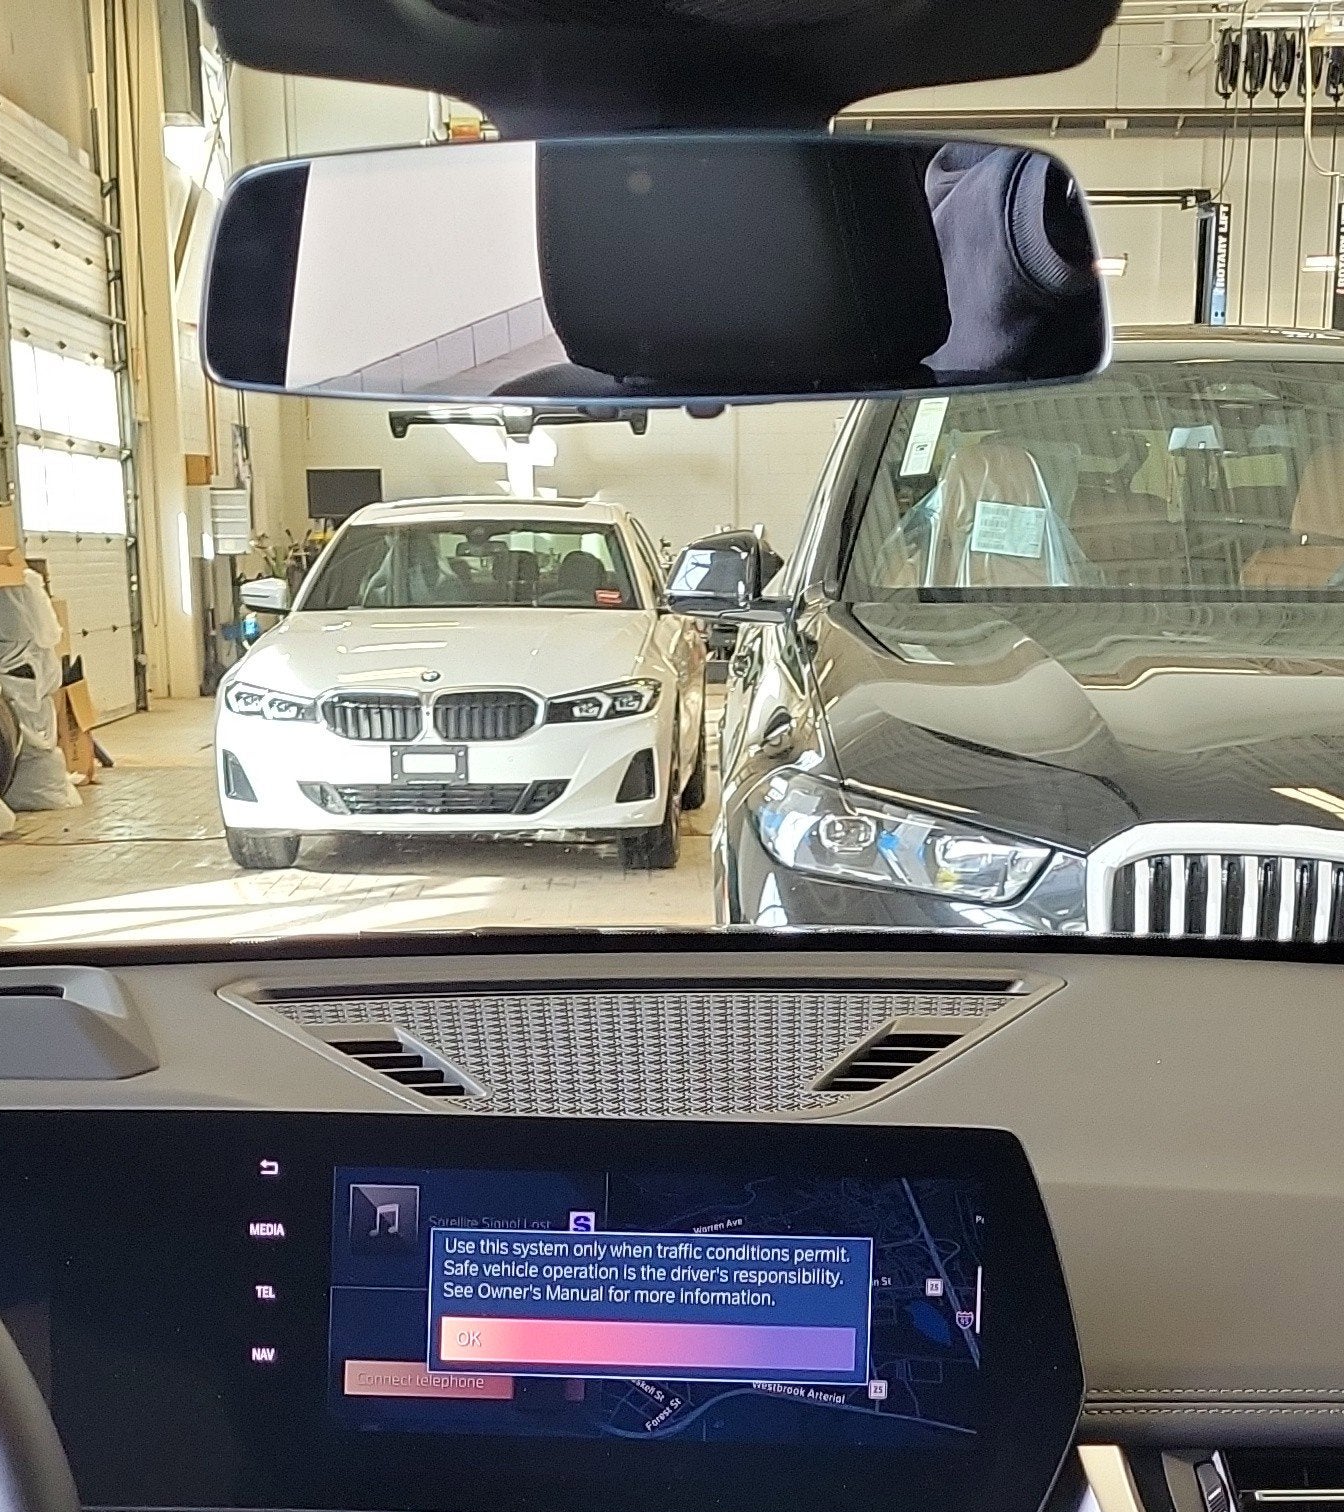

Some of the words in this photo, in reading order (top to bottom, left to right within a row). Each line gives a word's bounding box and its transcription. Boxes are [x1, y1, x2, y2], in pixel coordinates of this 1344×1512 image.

[1218, 204, 1230, 233] LIFT
[1215, 235, 1227, 287] ROTARY
[249, 1222, 285, 1237] MEDIA
[429, 1215, 479, 1229] Satellite
[445, 1237, 476, 1254] Use
[480, 1238, 509, 1255] this
[512, 1240, 569, 1259] system
[573, 1240, 607, 1261] only
[610, 1241, 653, 1259] when
[656, 1243, 703, 1260] traffic
[706, 1244, 790, 1261] conditions
[794, 1246, 850, 1265] permit.
[443, 1259, 479, 1277] Safe
[482, 1260, 539, 1278] vehicle
[542, 1263, 618, 1282] operation
[623, 1264, 637, 1281] is
[640, 1264, 667, 1281] the
[670, 1265, 729, 1282] driver's
[733, 1267, 844, 1288] responsibility.
[255, 1285, 276, 1299] TEL
[443, 1282, 474, 1298] See
[477, 1282, 542, 1300] Owner's
[546, 1284, 604, 1301] Manual
[608, 1286, 631, 1302] for
[634, 1288, 676, 1303] more
[680, 1287, 775, 1306] information.
[457, 1330, 482, 1347] OK
[252, 1347, 276, 1362] NAV
[358, 1372, 412, 1387] Connect
[416, 1374, 485, 1390] telephone
[752, 1381, 805, 1398] Westbrook
[807, 1389, 846, 1404] Arterial
[645, 1406, 673, 1432] Forest
[669, 1397, 682, 1410] St
